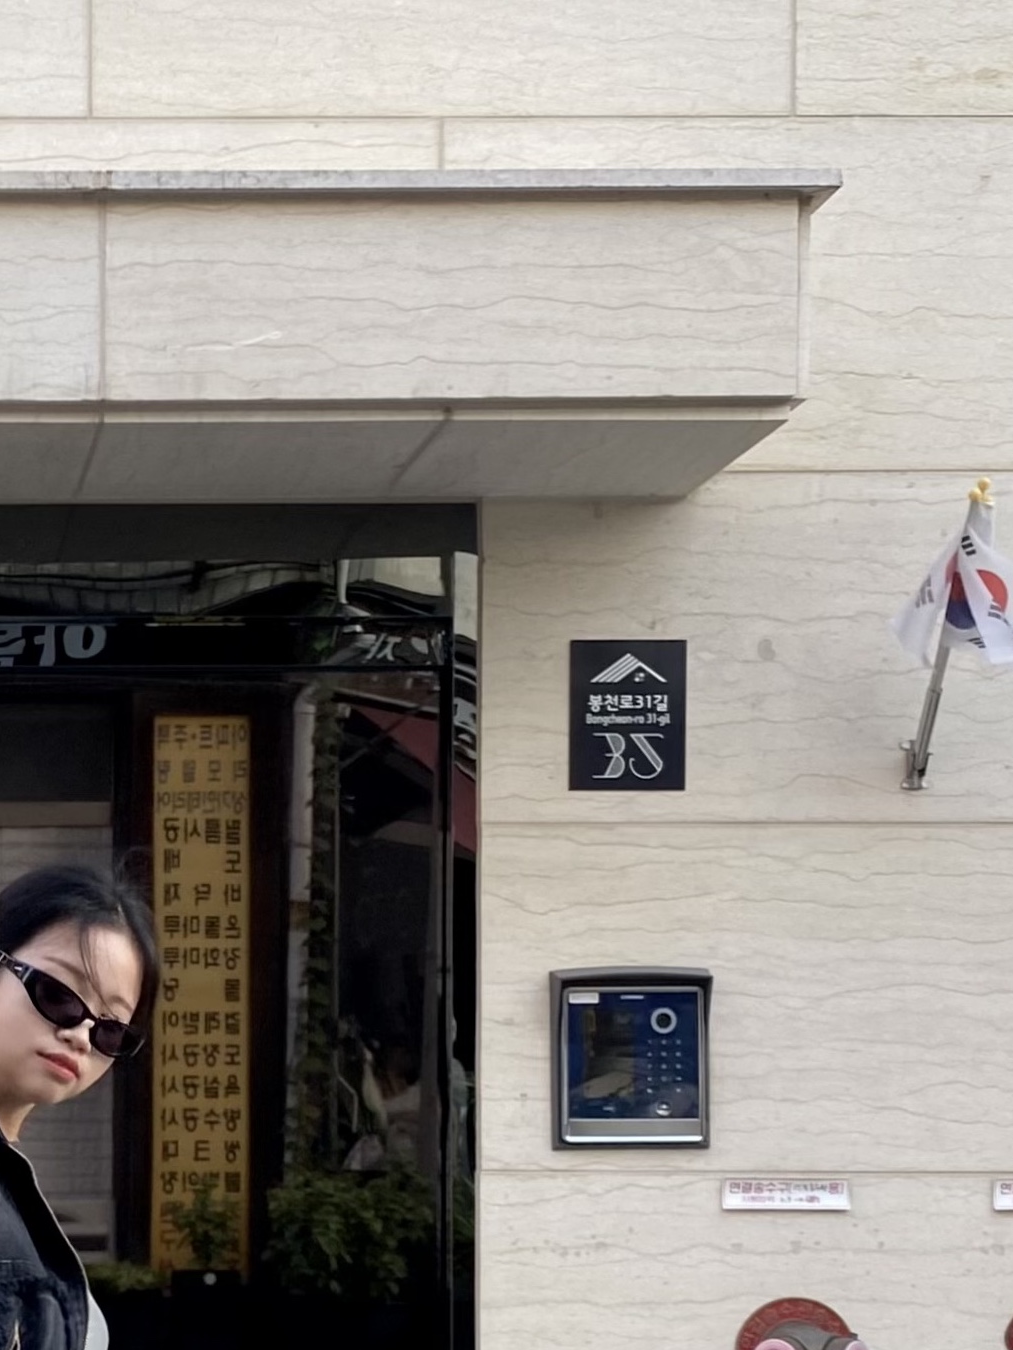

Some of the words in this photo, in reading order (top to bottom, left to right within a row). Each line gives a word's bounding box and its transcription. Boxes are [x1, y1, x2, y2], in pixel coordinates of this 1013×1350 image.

[587, 694, 669, 712] 봉천로31길
[646, 713, 671, 726] 31-gil
[591, 732, 665, 780] 35
